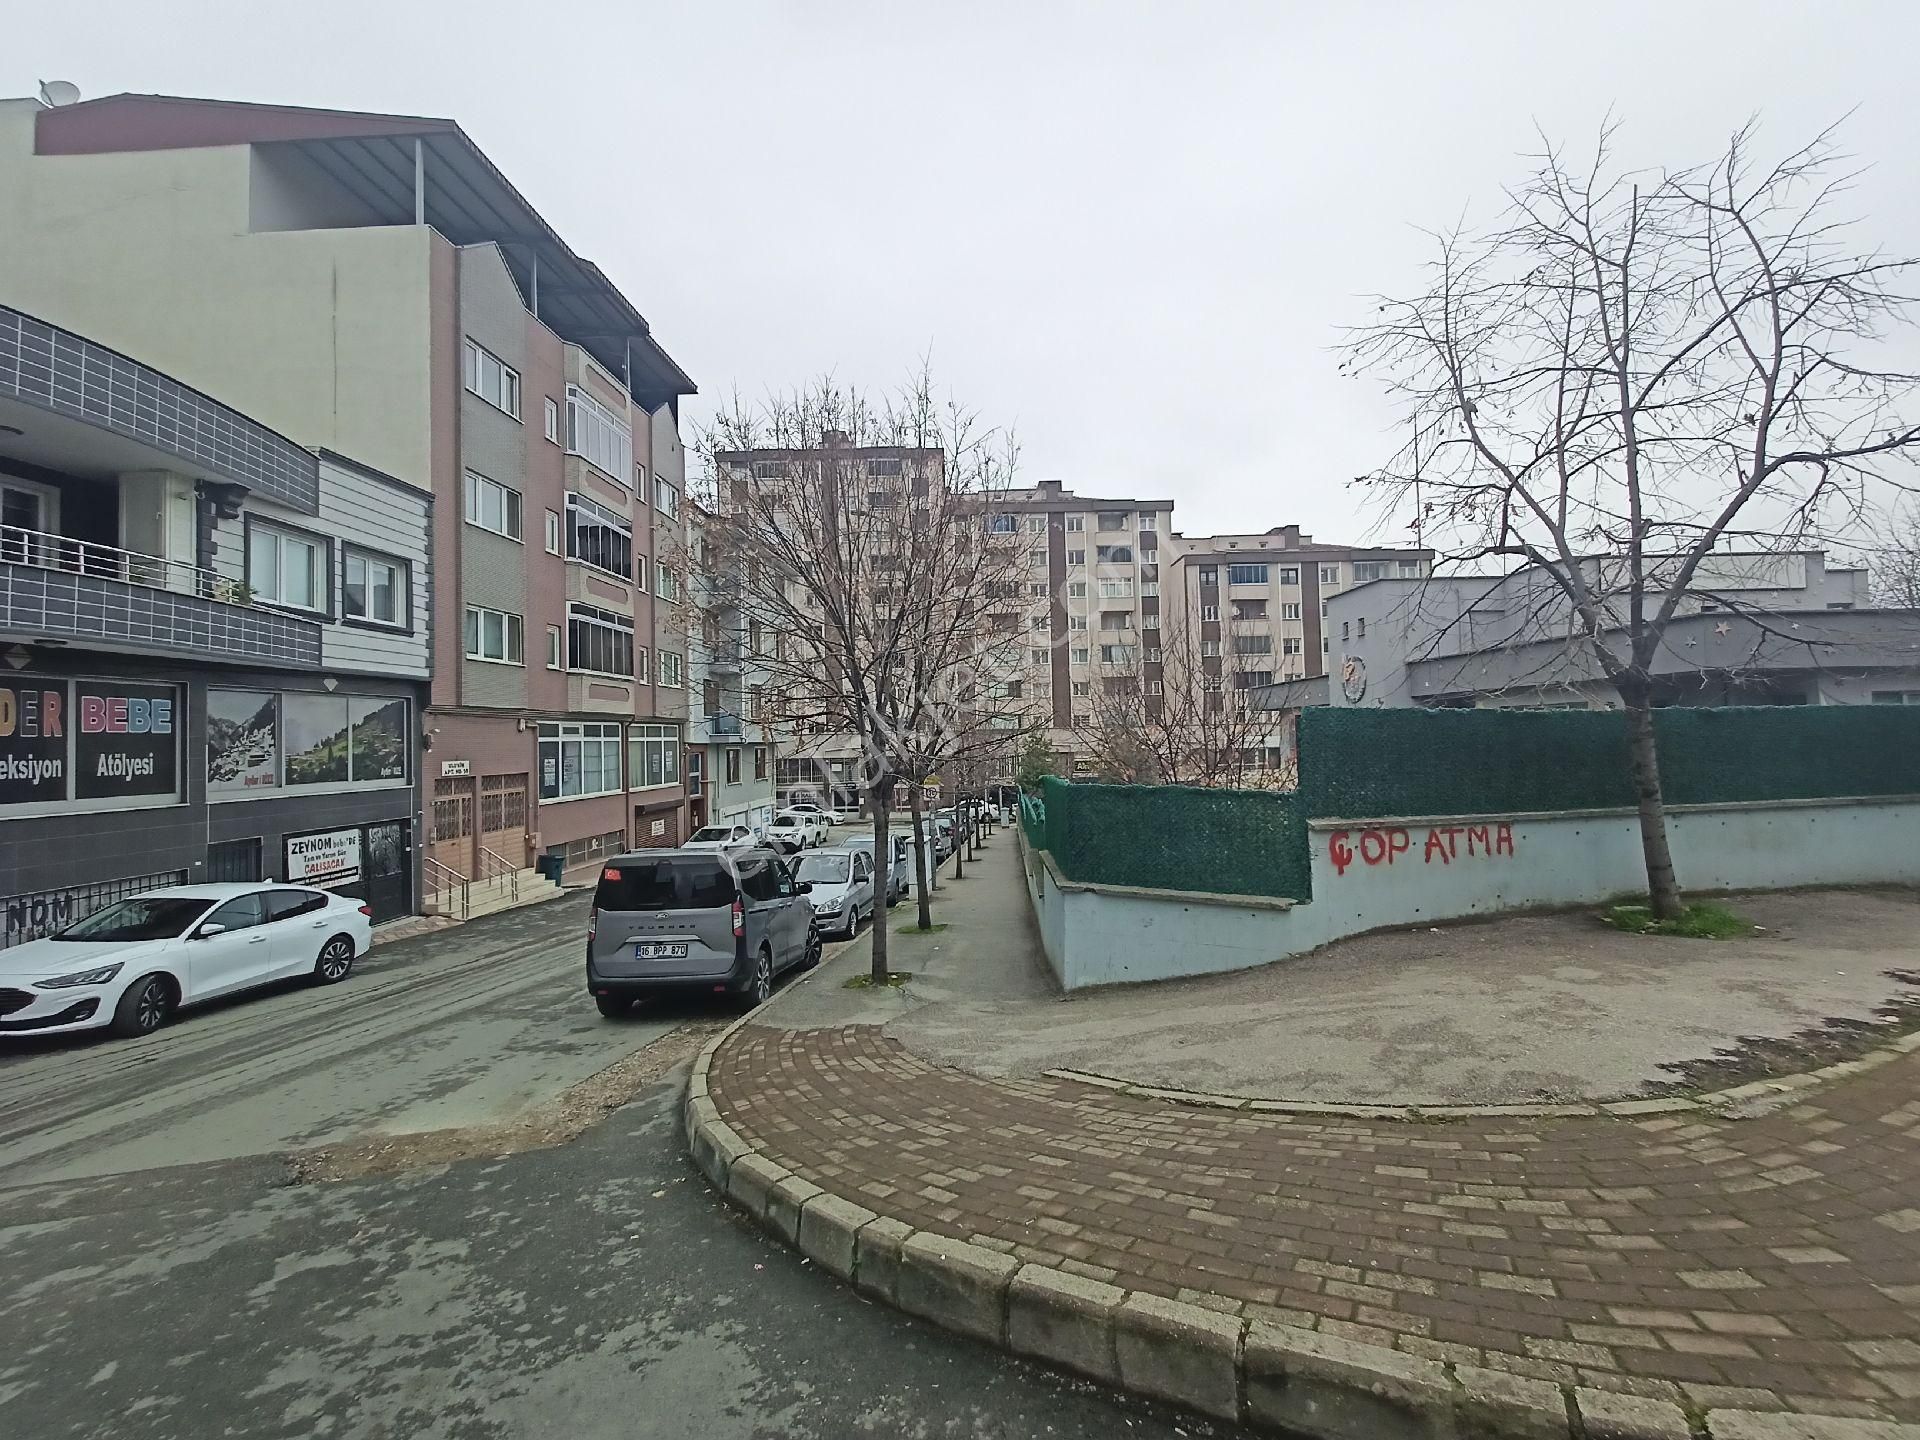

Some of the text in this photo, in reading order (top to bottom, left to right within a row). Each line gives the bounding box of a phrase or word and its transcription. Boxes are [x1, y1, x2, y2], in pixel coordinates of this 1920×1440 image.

[81, 695, 172, 734] BEBE
[97, 752, 154, 782] Atölyesi
[291, 837, 332, 855] ZEYNOM
[1424, 822, 1514, 865] ATMA
[641, 946, 650, 956] 16
[671, 945, 686, 955] 870
